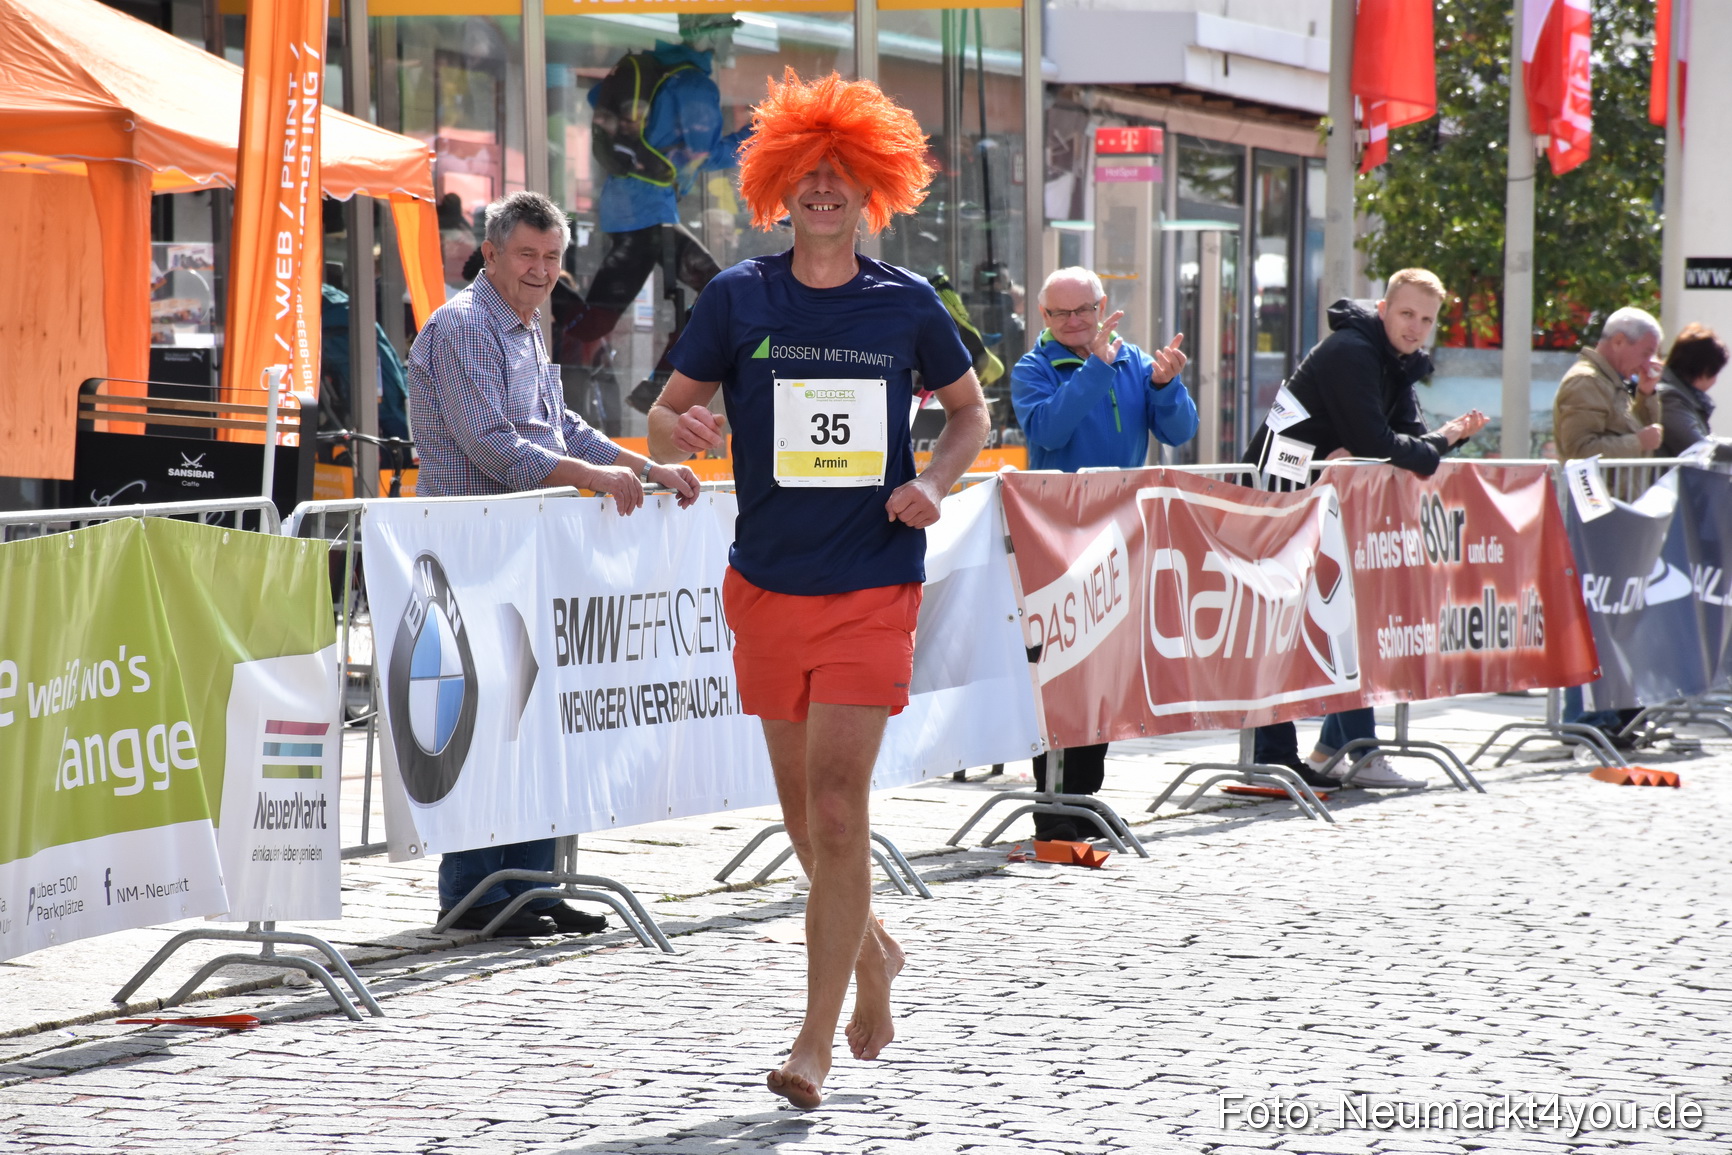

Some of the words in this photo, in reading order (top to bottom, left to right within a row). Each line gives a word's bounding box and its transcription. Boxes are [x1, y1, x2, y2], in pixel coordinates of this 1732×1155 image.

[281, 72, 297, 188] PRINT
[275, 231, 293, 320] WEB
[771, 345, 820, 361] GOSSEN
[824, 348, 894, 368] METRAWATT
[816, 390, 855, 399] BOCK
[810, 413, 851, 446] 35
[168, 468, 214, 479] SANSIBAR
[813, 457, 848, 468] Armin
[1278, 451, 1300, 465] swn
[1579, 468, 1593, 497] swn
[1355, 540, 1366, 570] die
[1367, 516, 1425, 569] meisten
[1468, 536, 1486, 564] und
[1488, 535, 1504, 564] die
[404, 560, 462, 640] BMW
[1028, 591, 1077, 665] DAS
[1083, 547, 1122, 635] NEUE
[1378, 614, 1436, 659] schönsten
[1520, 585, 1544, 648] Hits
[81, 645, 150, 702] wo's
[558, 687, 628, 735] WENIGER
[629, 675, 732, 727] VERBRAUCH.
[36, 882, 58, 899] über
[59, 875, 78, 894] 500
[36, 899, 84, 922] Parkplätze
